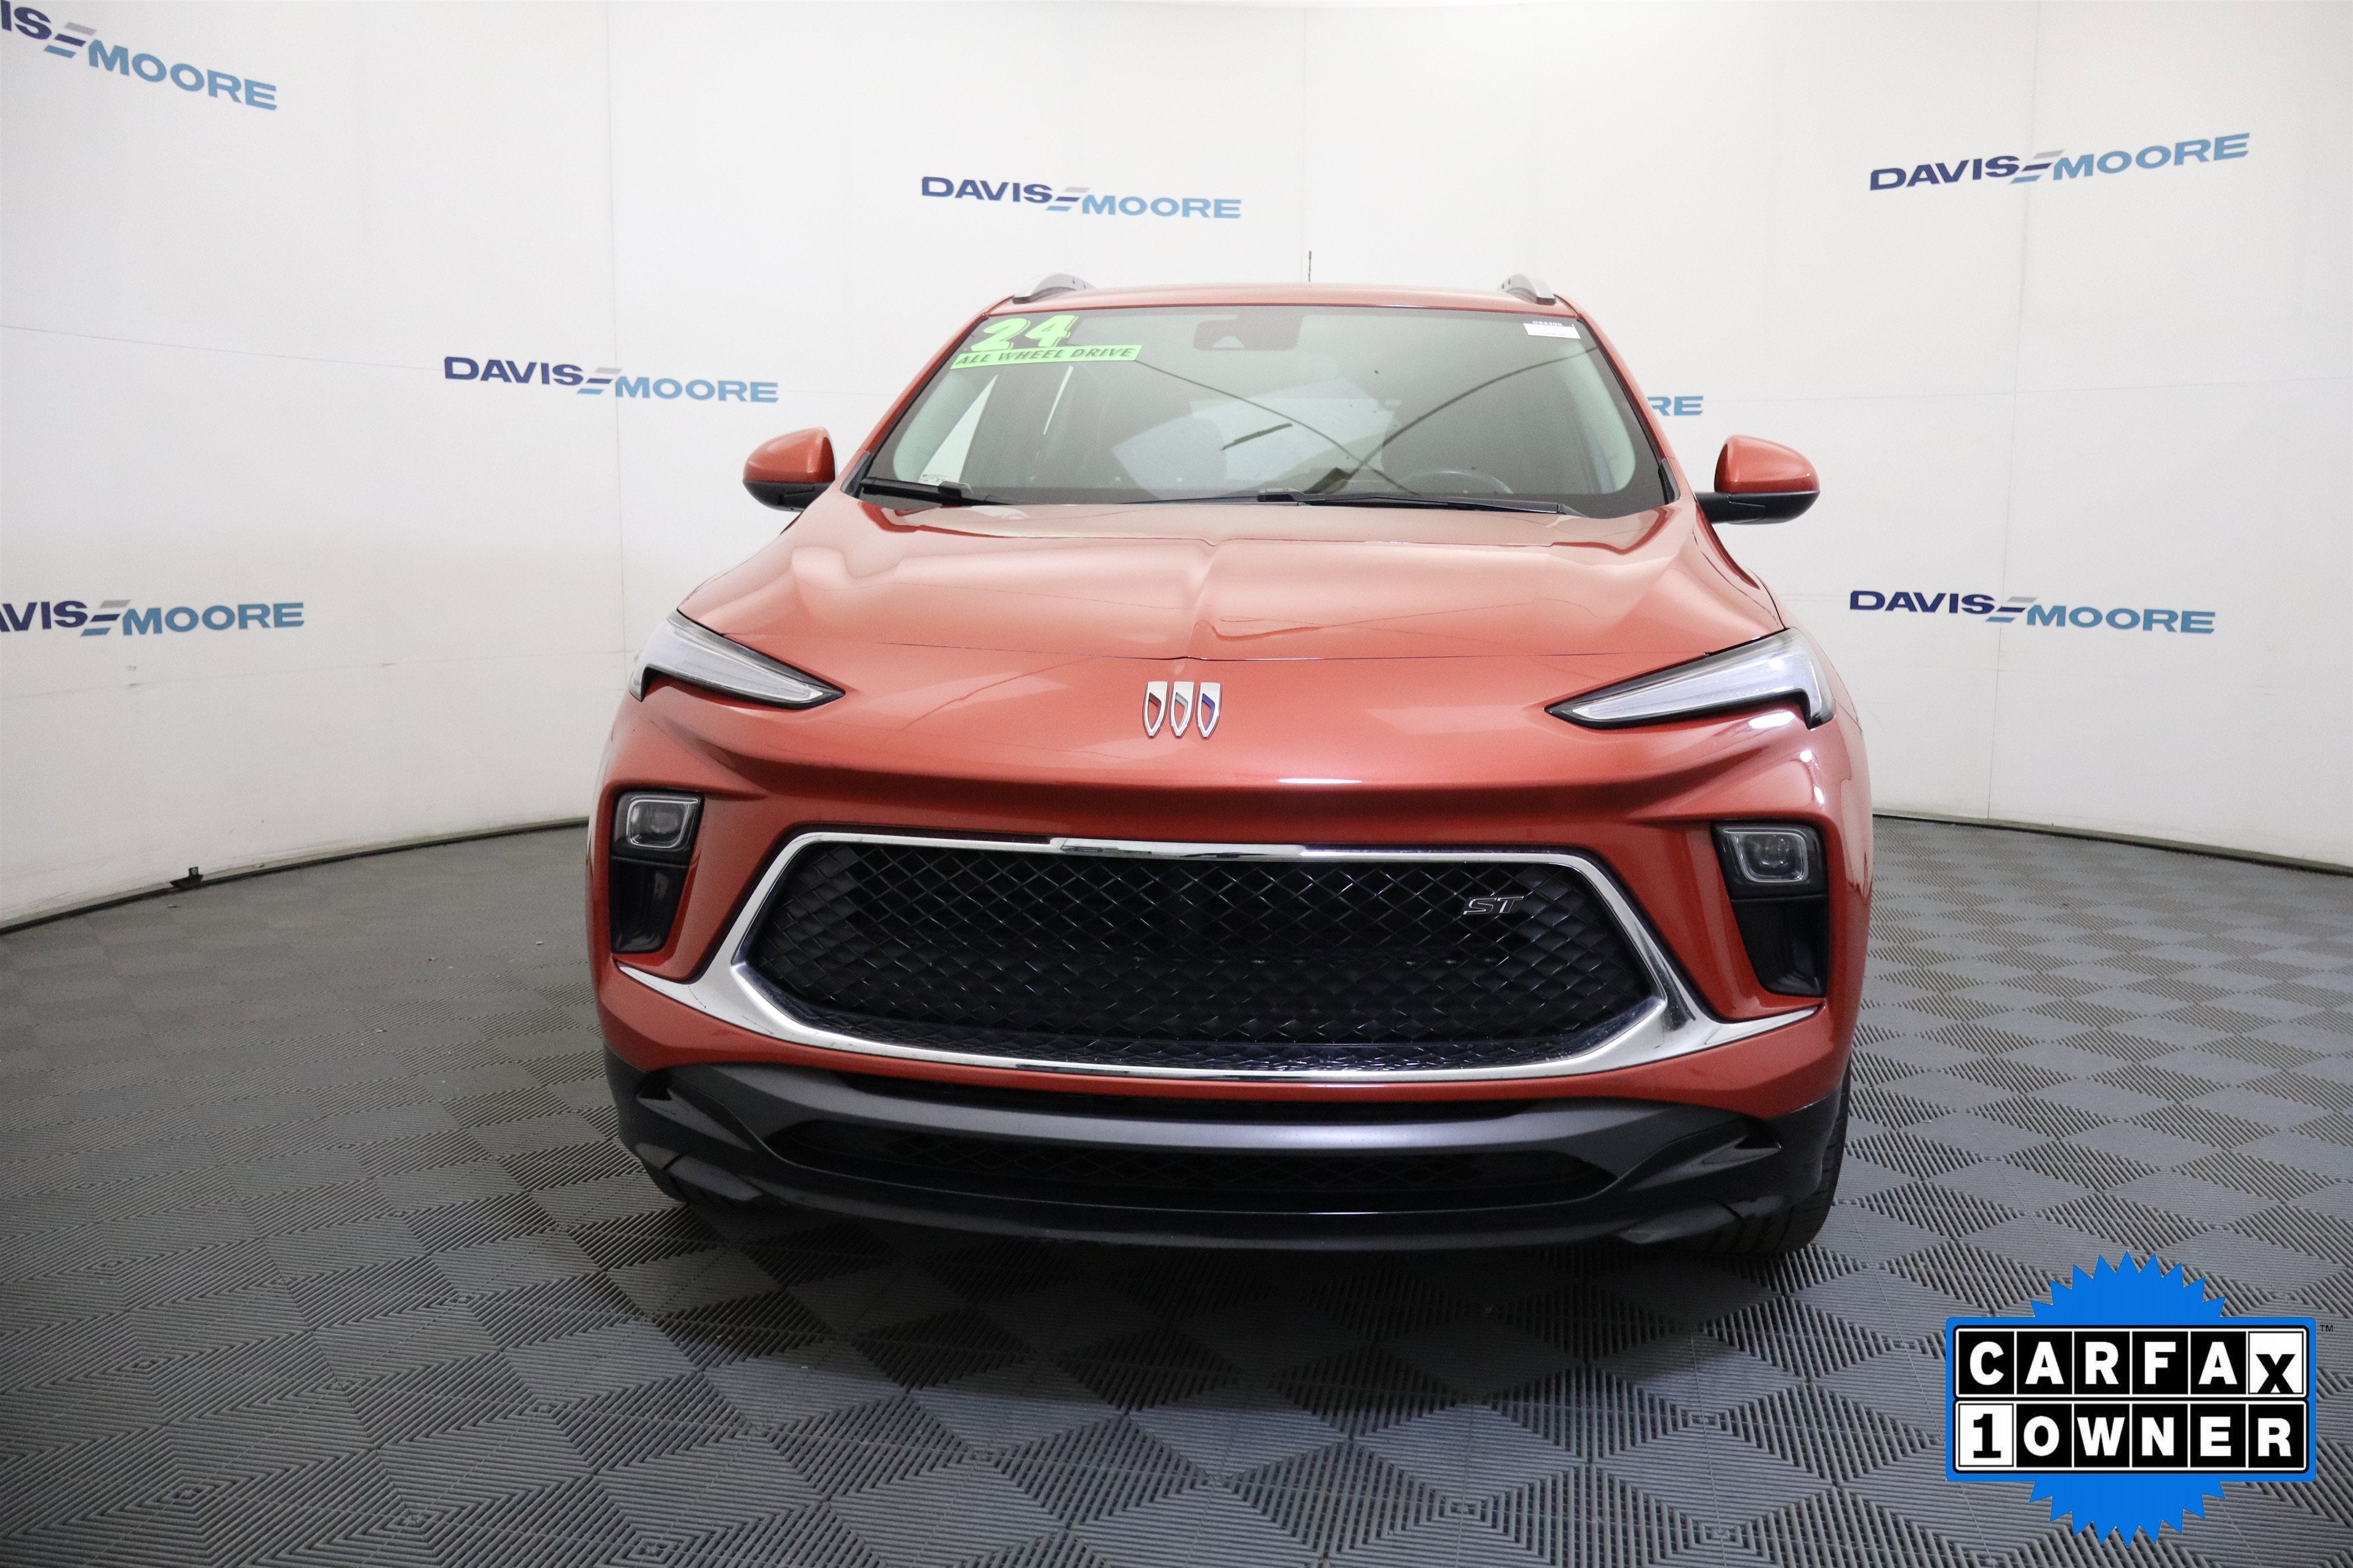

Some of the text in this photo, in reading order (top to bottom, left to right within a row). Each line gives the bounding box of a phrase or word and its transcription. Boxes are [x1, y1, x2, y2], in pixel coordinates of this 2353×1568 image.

[88, 38, 277, 111] MOORE
[1870, 133, 2250, 191] DAVIS MOORE
[922, 176, 1242, 219] DAVIS MOORE
[971, 315, 1078, 351] 24
[954, 347, 1136, 365] ALL WHEEL DRIVE
[443, 356, 779, 403] DAVIS MOORE
[122, 602, 304, 636] MOORE
[1849, 590, 2216, 634] DAVIS MOORE
[1463, 896, 1525, 915] ST
